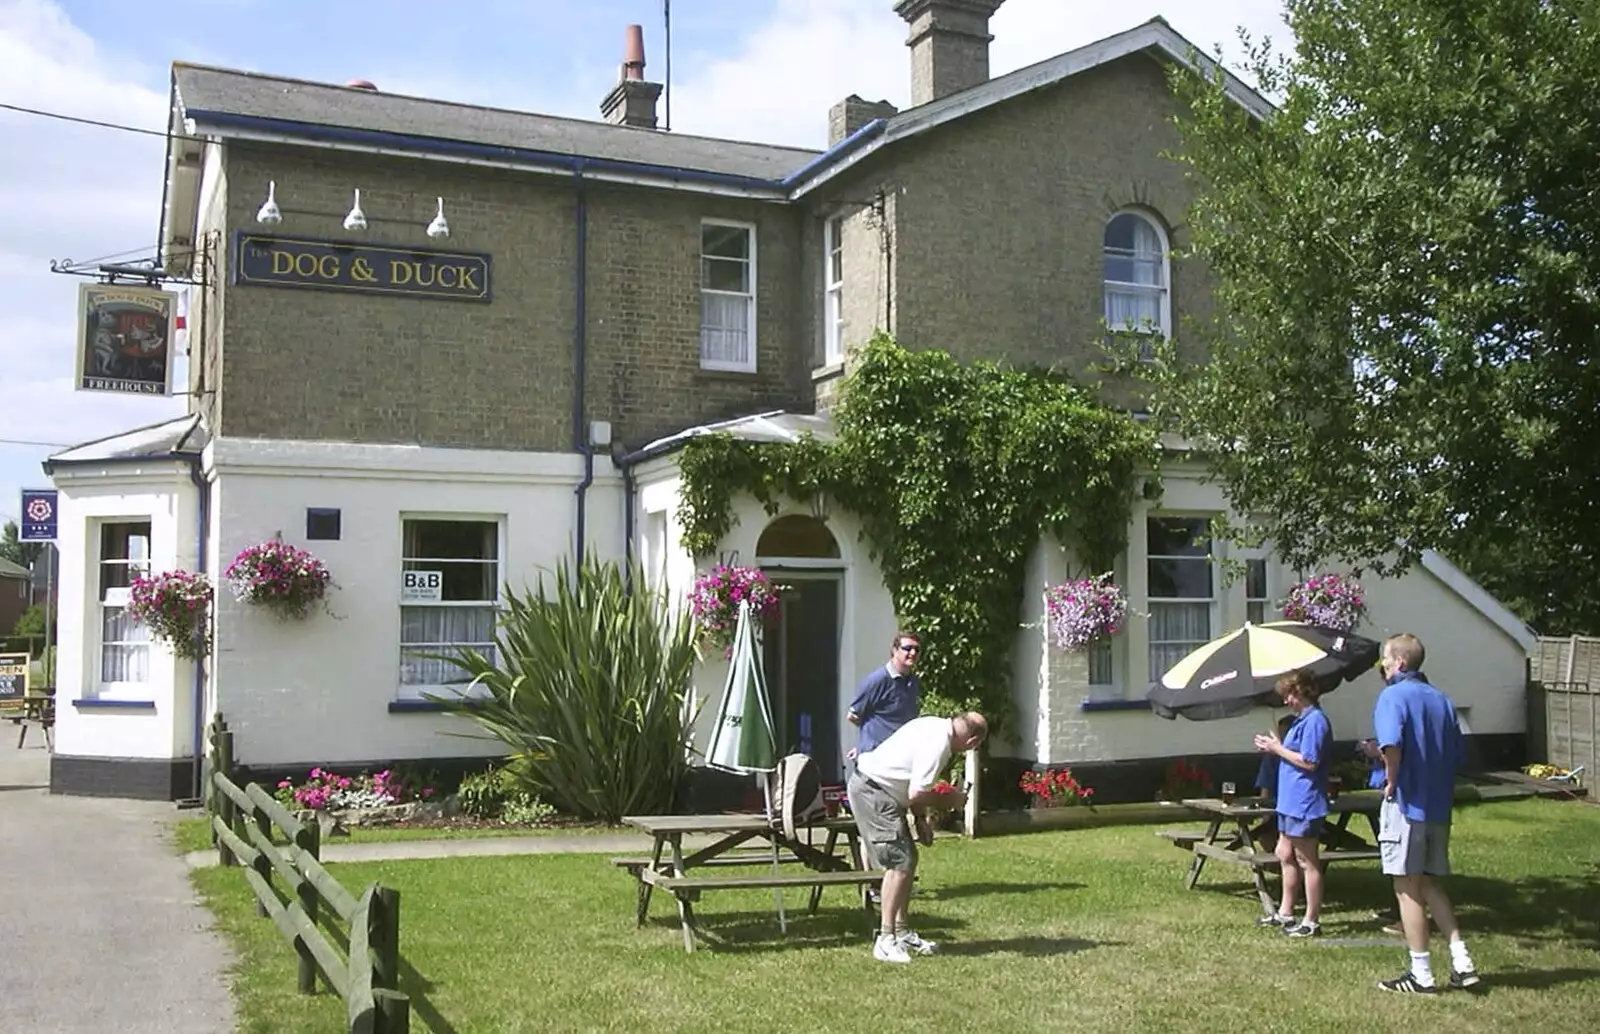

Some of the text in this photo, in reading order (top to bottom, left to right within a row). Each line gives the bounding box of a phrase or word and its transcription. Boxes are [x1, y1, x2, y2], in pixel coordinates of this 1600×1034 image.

[271, 251, 340, 279] DOG
[350, 257, 379, 282] &
[390, 261, 479, 290] DUCK
[90, 380, 157, 393] FREEHOUSE
[405, 573, 439, 588] B&B
